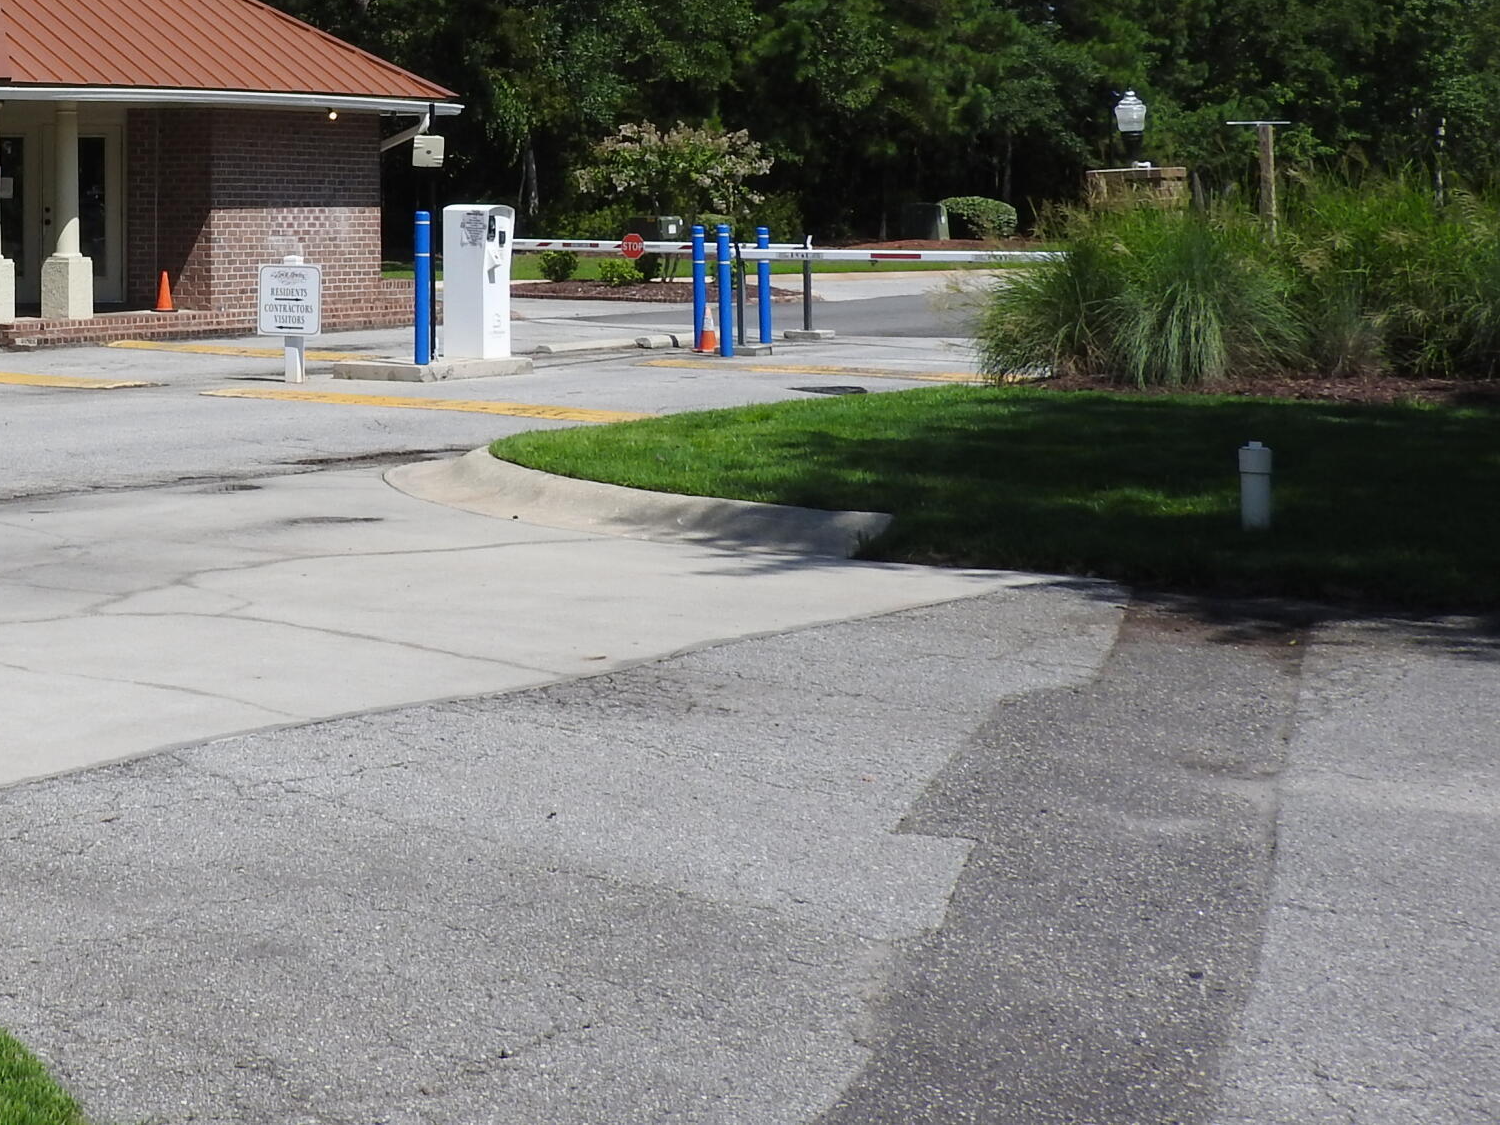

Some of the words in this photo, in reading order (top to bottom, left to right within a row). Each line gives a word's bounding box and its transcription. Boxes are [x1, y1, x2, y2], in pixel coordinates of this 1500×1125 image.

[622, 241, 644, 251] STOP
[270, 287, 308, 297] RESIDENTS
[264, 304, 313, 313] CONTRACTORS
[274, 314, 305, 324] VISITORS
